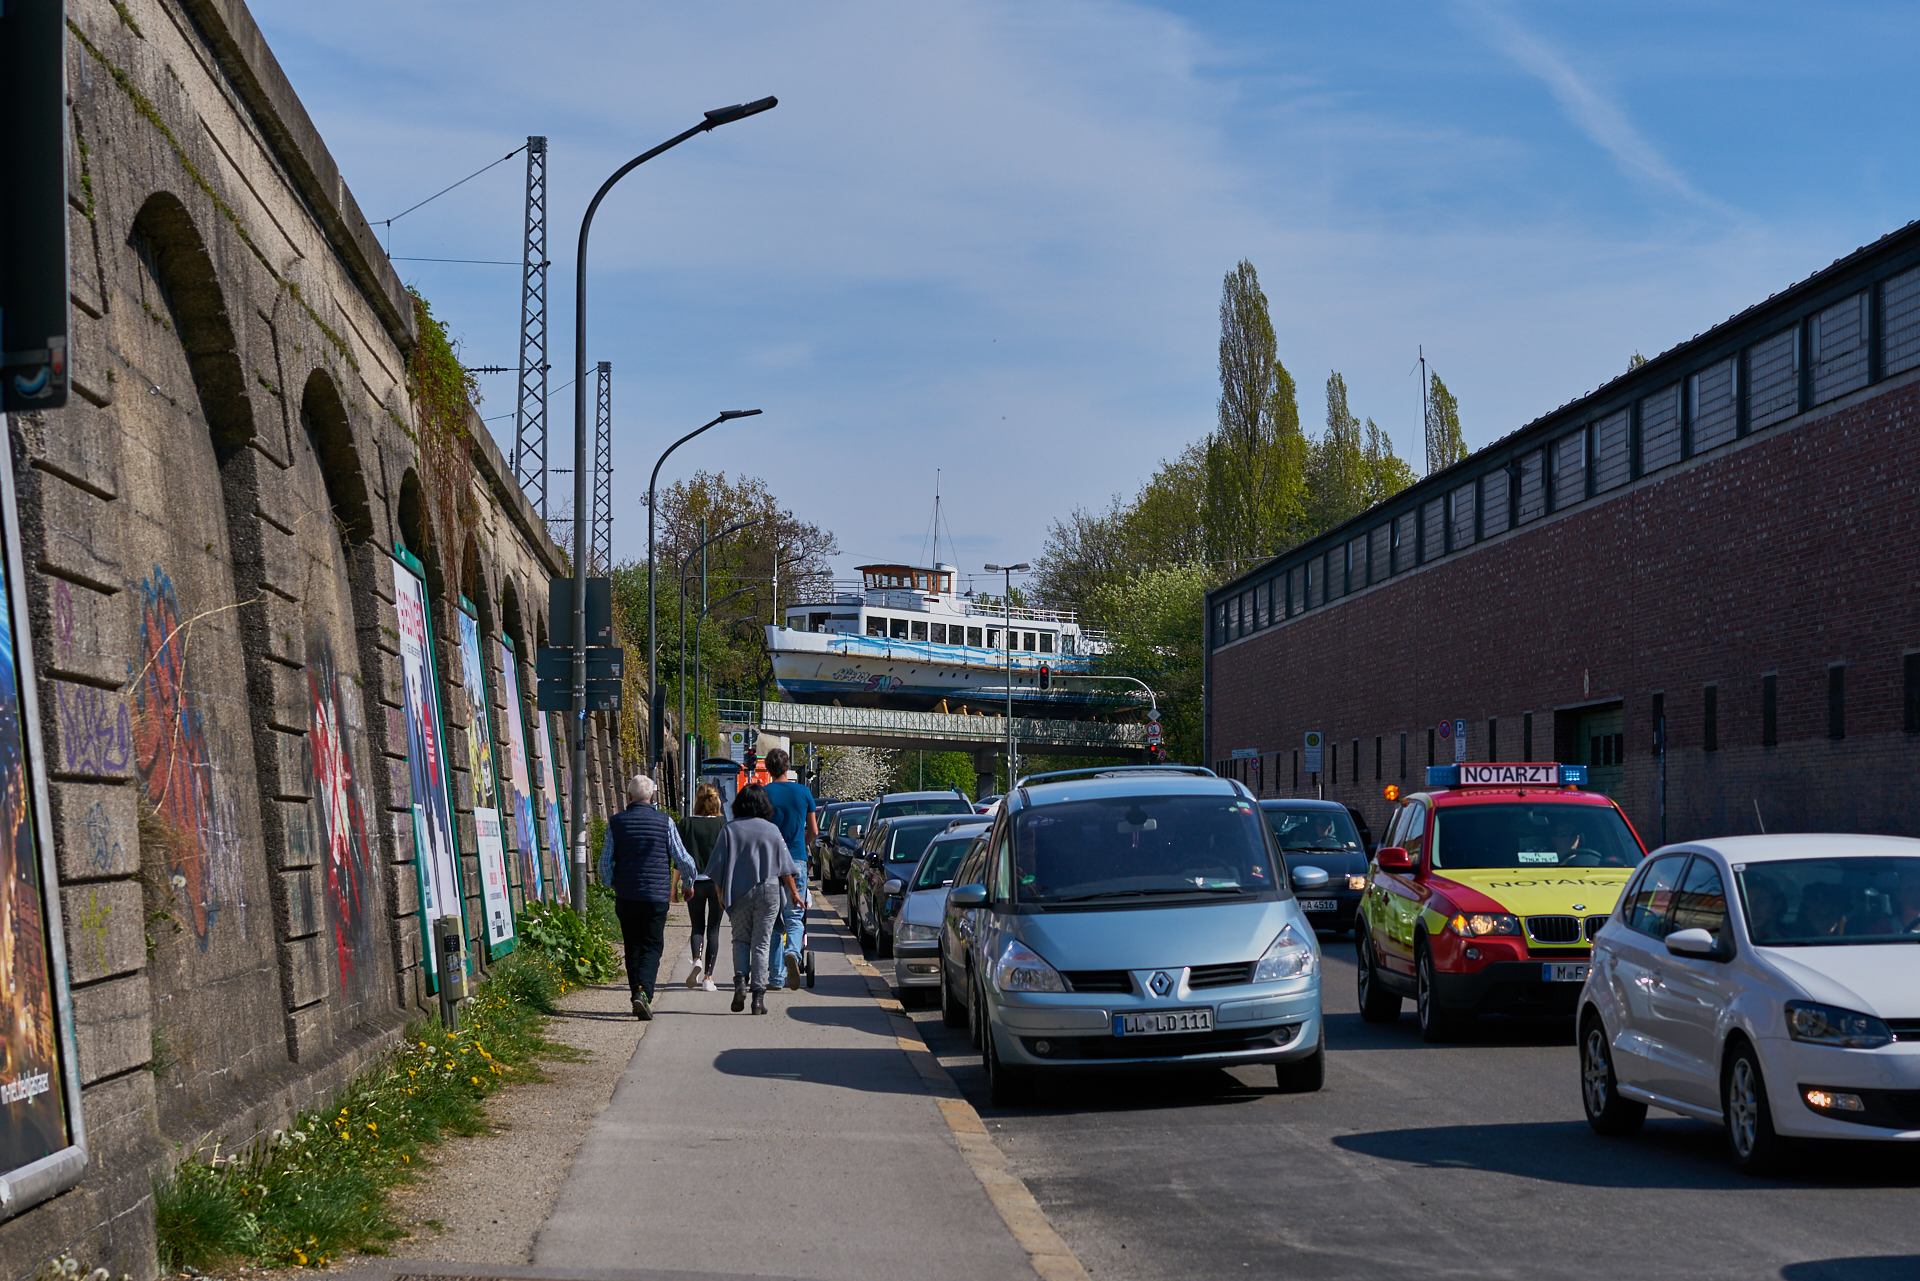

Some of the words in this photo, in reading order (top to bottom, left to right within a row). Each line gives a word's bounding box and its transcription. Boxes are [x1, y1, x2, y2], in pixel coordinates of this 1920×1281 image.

[1465, 766, 1553, 783] NOTARZT
[1314, 901, 1334, 909] 4516
[1557, 966, 1566, 979] M
[1575, 966, 1584, 979] F
[1124, 1017, 1145, 1033] LL
[1156, 1015, 1177, 1031] LD
[1181, 1013, 1210, 1030] 111
